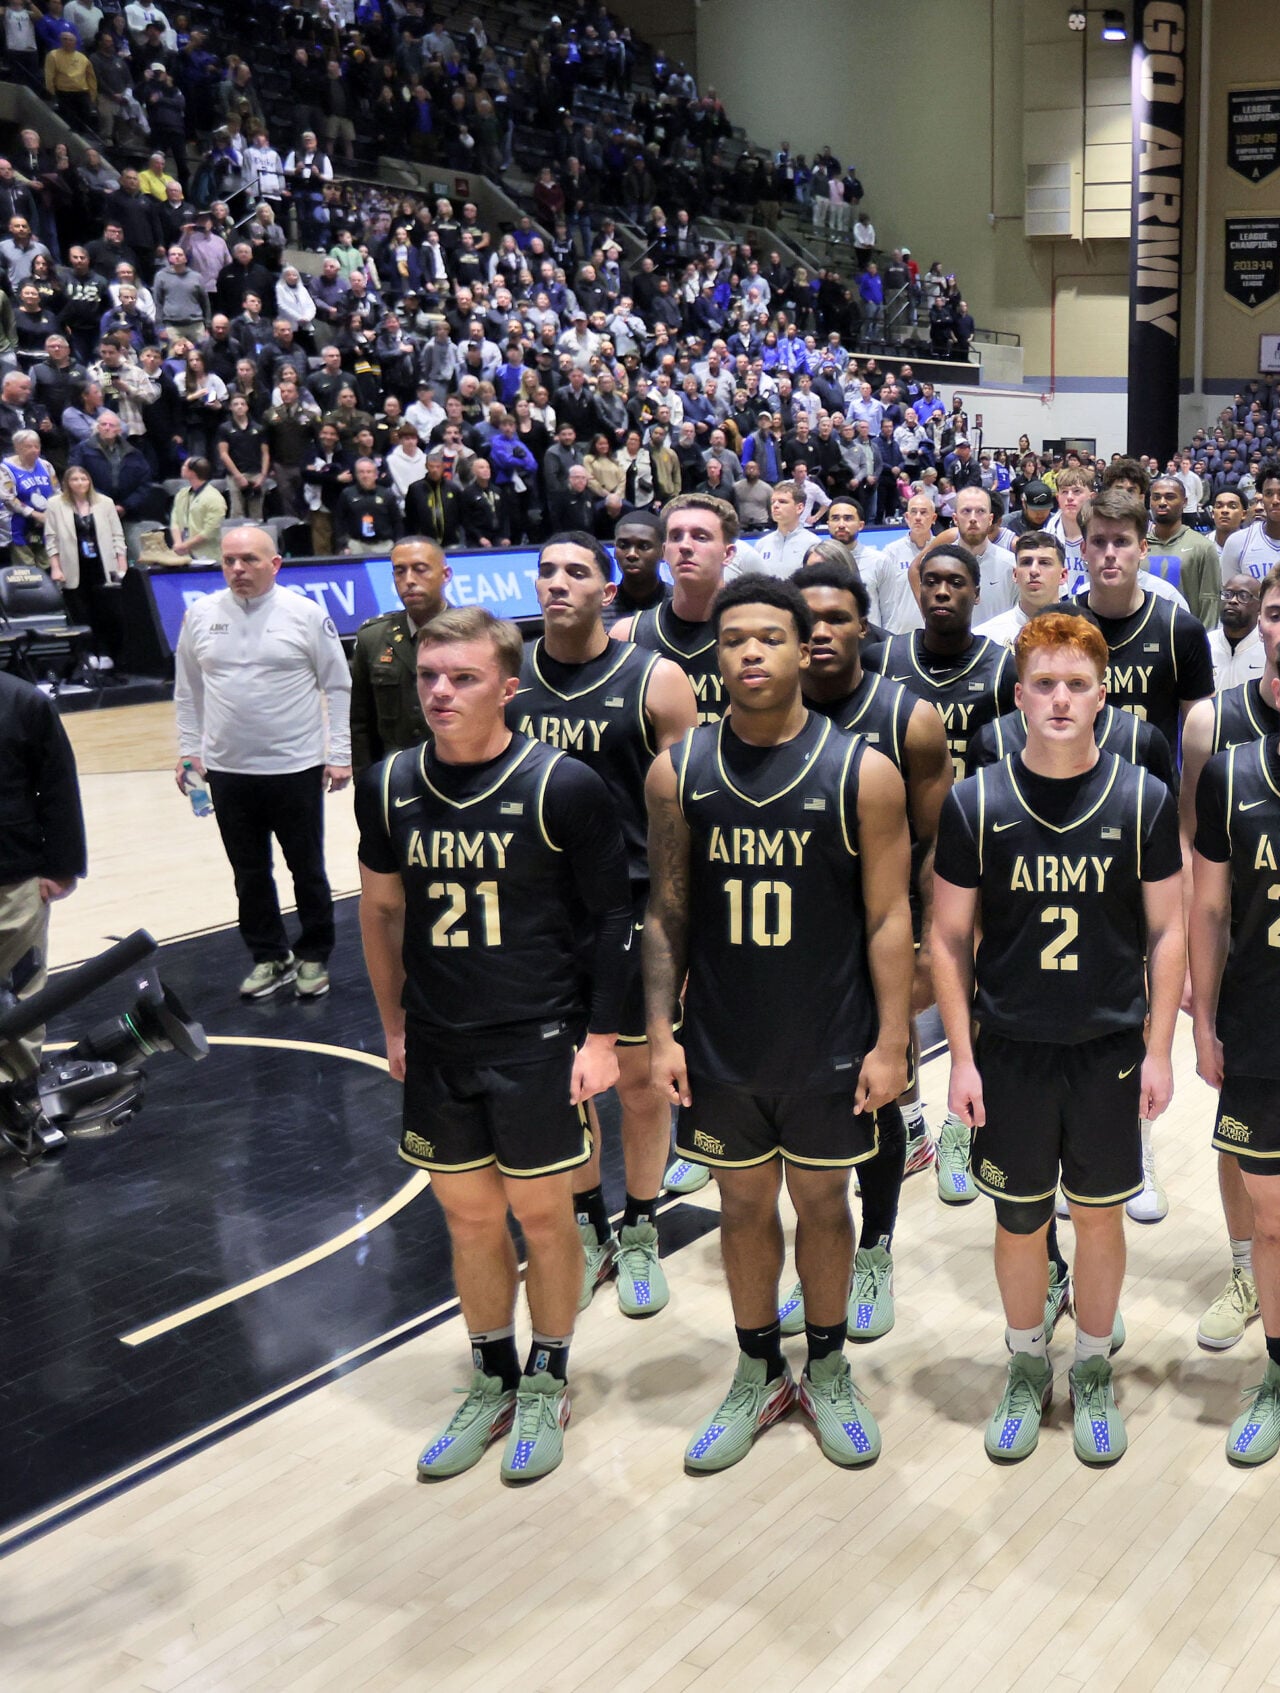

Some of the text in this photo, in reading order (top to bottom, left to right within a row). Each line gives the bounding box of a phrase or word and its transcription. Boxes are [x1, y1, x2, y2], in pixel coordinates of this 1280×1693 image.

[1233, 112, 1280, 123] CHAMPIONS
[1135, 0, 1185, 338] GO ARMY
[1230, 240, 1278, 250] CHAMPIONS
[1240, 232, 1268, 240] LEAGUE
[1234, 260, 1274, 270] 2013-14
[20, 476, 49, 490] DUKE
[1248, 562, 1273, 580] DU
[519, 715, 609, 752] ARMY
[408, 830, 514, 869] ARMY
[708, 826, 812, 866] ARMY
[1010, 856, 1113, 893] ARMY
[428, 881, 502, 948] 21
[724, 878, 792, 947] 10
[1040, 906, 1079, 971] 2
